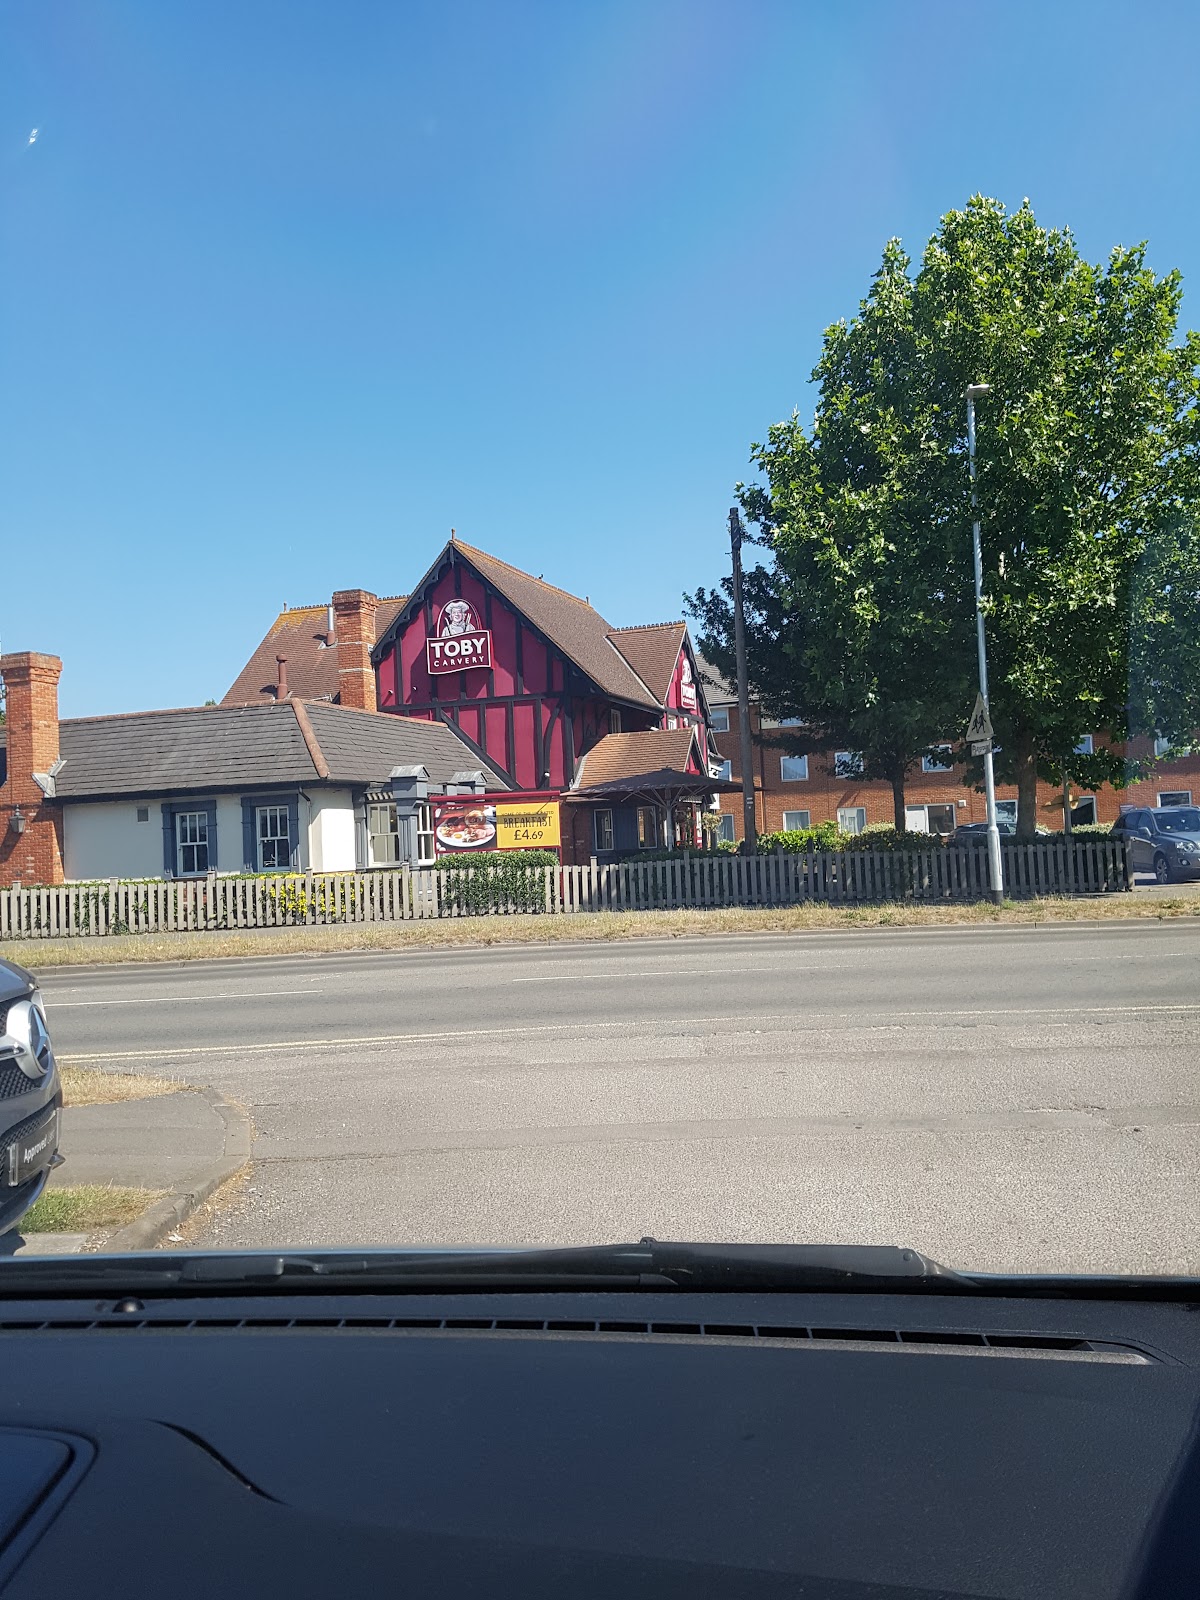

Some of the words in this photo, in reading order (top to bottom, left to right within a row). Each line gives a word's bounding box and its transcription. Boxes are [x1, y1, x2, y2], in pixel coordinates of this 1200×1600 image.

[430, 638, 486, 659] TOBY
[433, 655, 485, 667] CARVERY
[503, 816, 552, 828] BREAKFAST
[513, 829, 544, 841] £4.69
[23, 1134, 48, 1164] Approved
